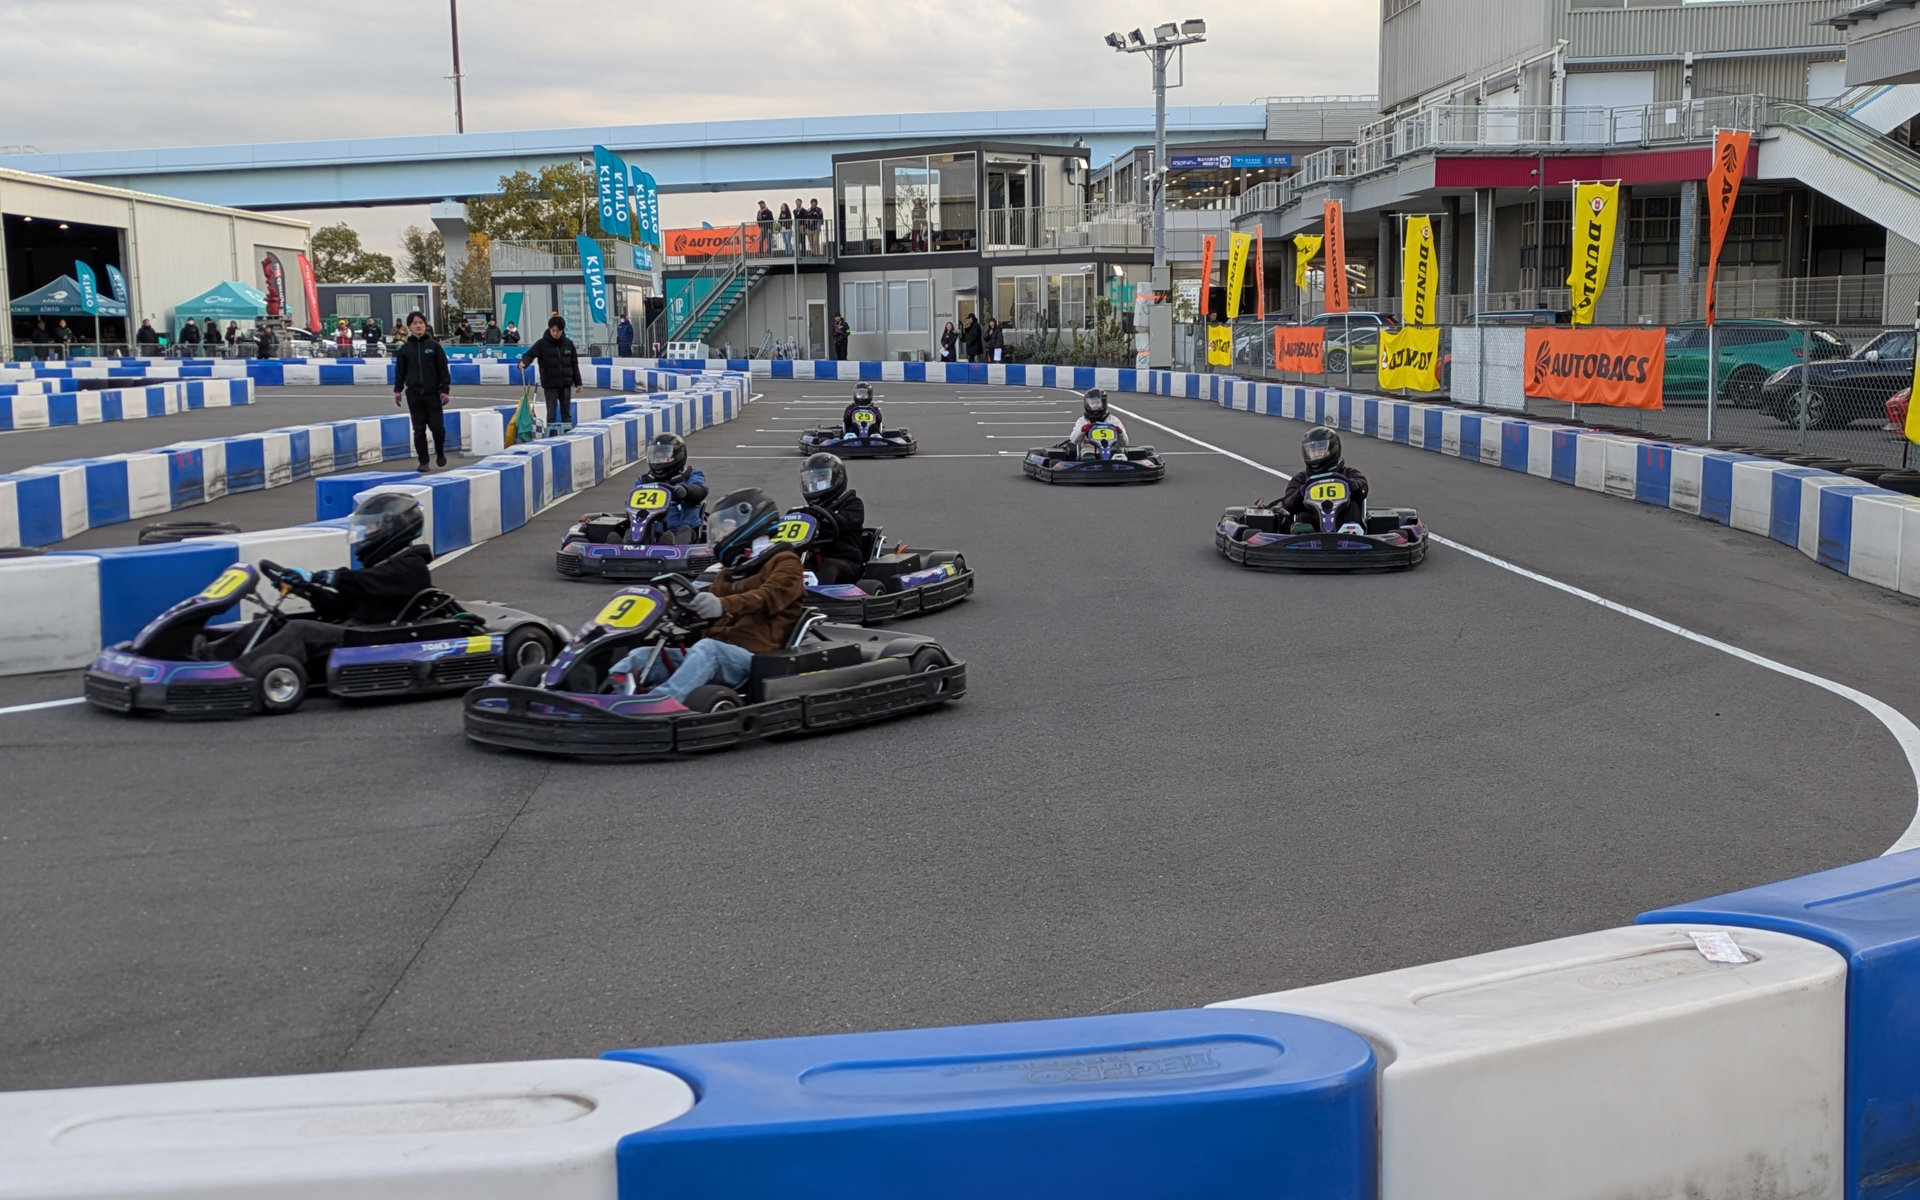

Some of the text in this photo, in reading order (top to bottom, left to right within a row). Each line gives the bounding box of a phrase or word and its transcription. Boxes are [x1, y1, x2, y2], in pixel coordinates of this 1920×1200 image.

[1577, 219, 1602, 309] DUNLO
[1285, 341, 1320, 359] AUTOBACS
[1550, 352, 1649, 384] AUTOBACS
[1099, 430, 1107, 438] 5
[636, 492, 658, 505] 24
[1319, 486, 1337, 498] 16
[774, 523, 801, 539] 28
[608, 599, 637, 620] 9
